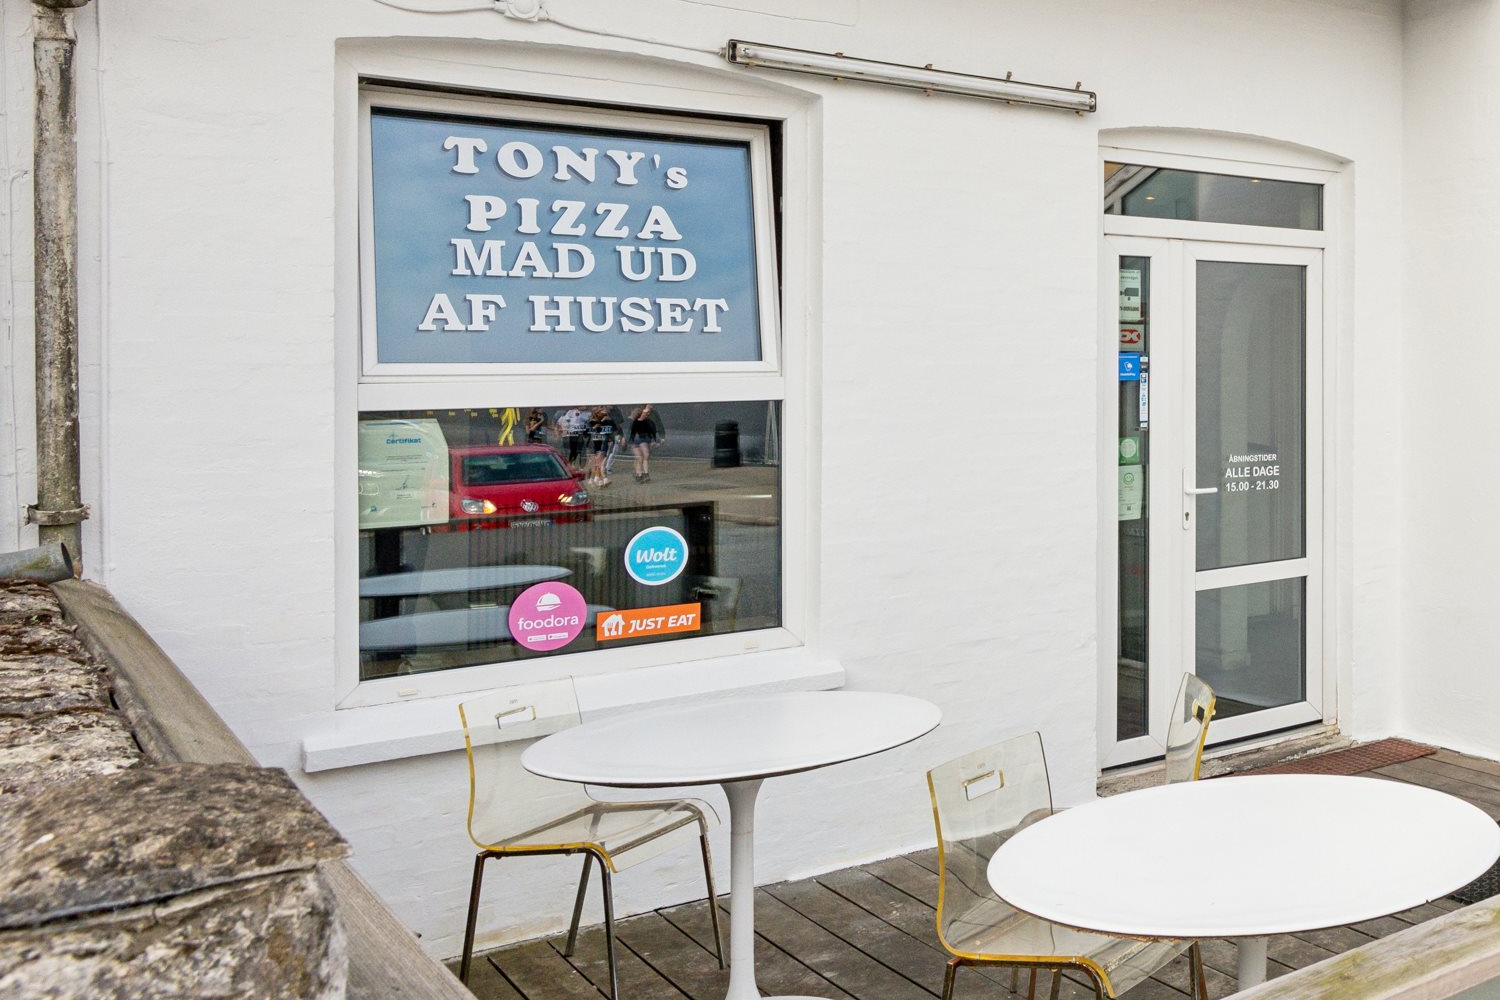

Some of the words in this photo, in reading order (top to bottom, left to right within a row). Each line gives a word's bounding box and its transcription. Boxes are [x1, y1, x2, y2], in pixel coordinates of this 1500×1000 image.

[443, 136, 688, 189] TONY's
[464, 194, 682, 241] PIZZA
[450, 238, 595, 279] MAD
[615, 244, 697, 282] UD
[417, 293, 506, 332] AF
[528, 295, 729, 334] HUSET
[1229, 454, 1277, 462] ÅBNINGSTIDER
[1225, 467, 1250, 478] ALLE
[1253, 466, 1280, 477] DAGE
[1225, 482, 1249, 491] 15.00
[1256, 480, 1279, 490] 21.30
[636, 547, 677, 563] Wolt
[518, 614, 579, 631] foodora
[628, 616, 665, 633] JUST
[668, 613, 696, 628] EAT
